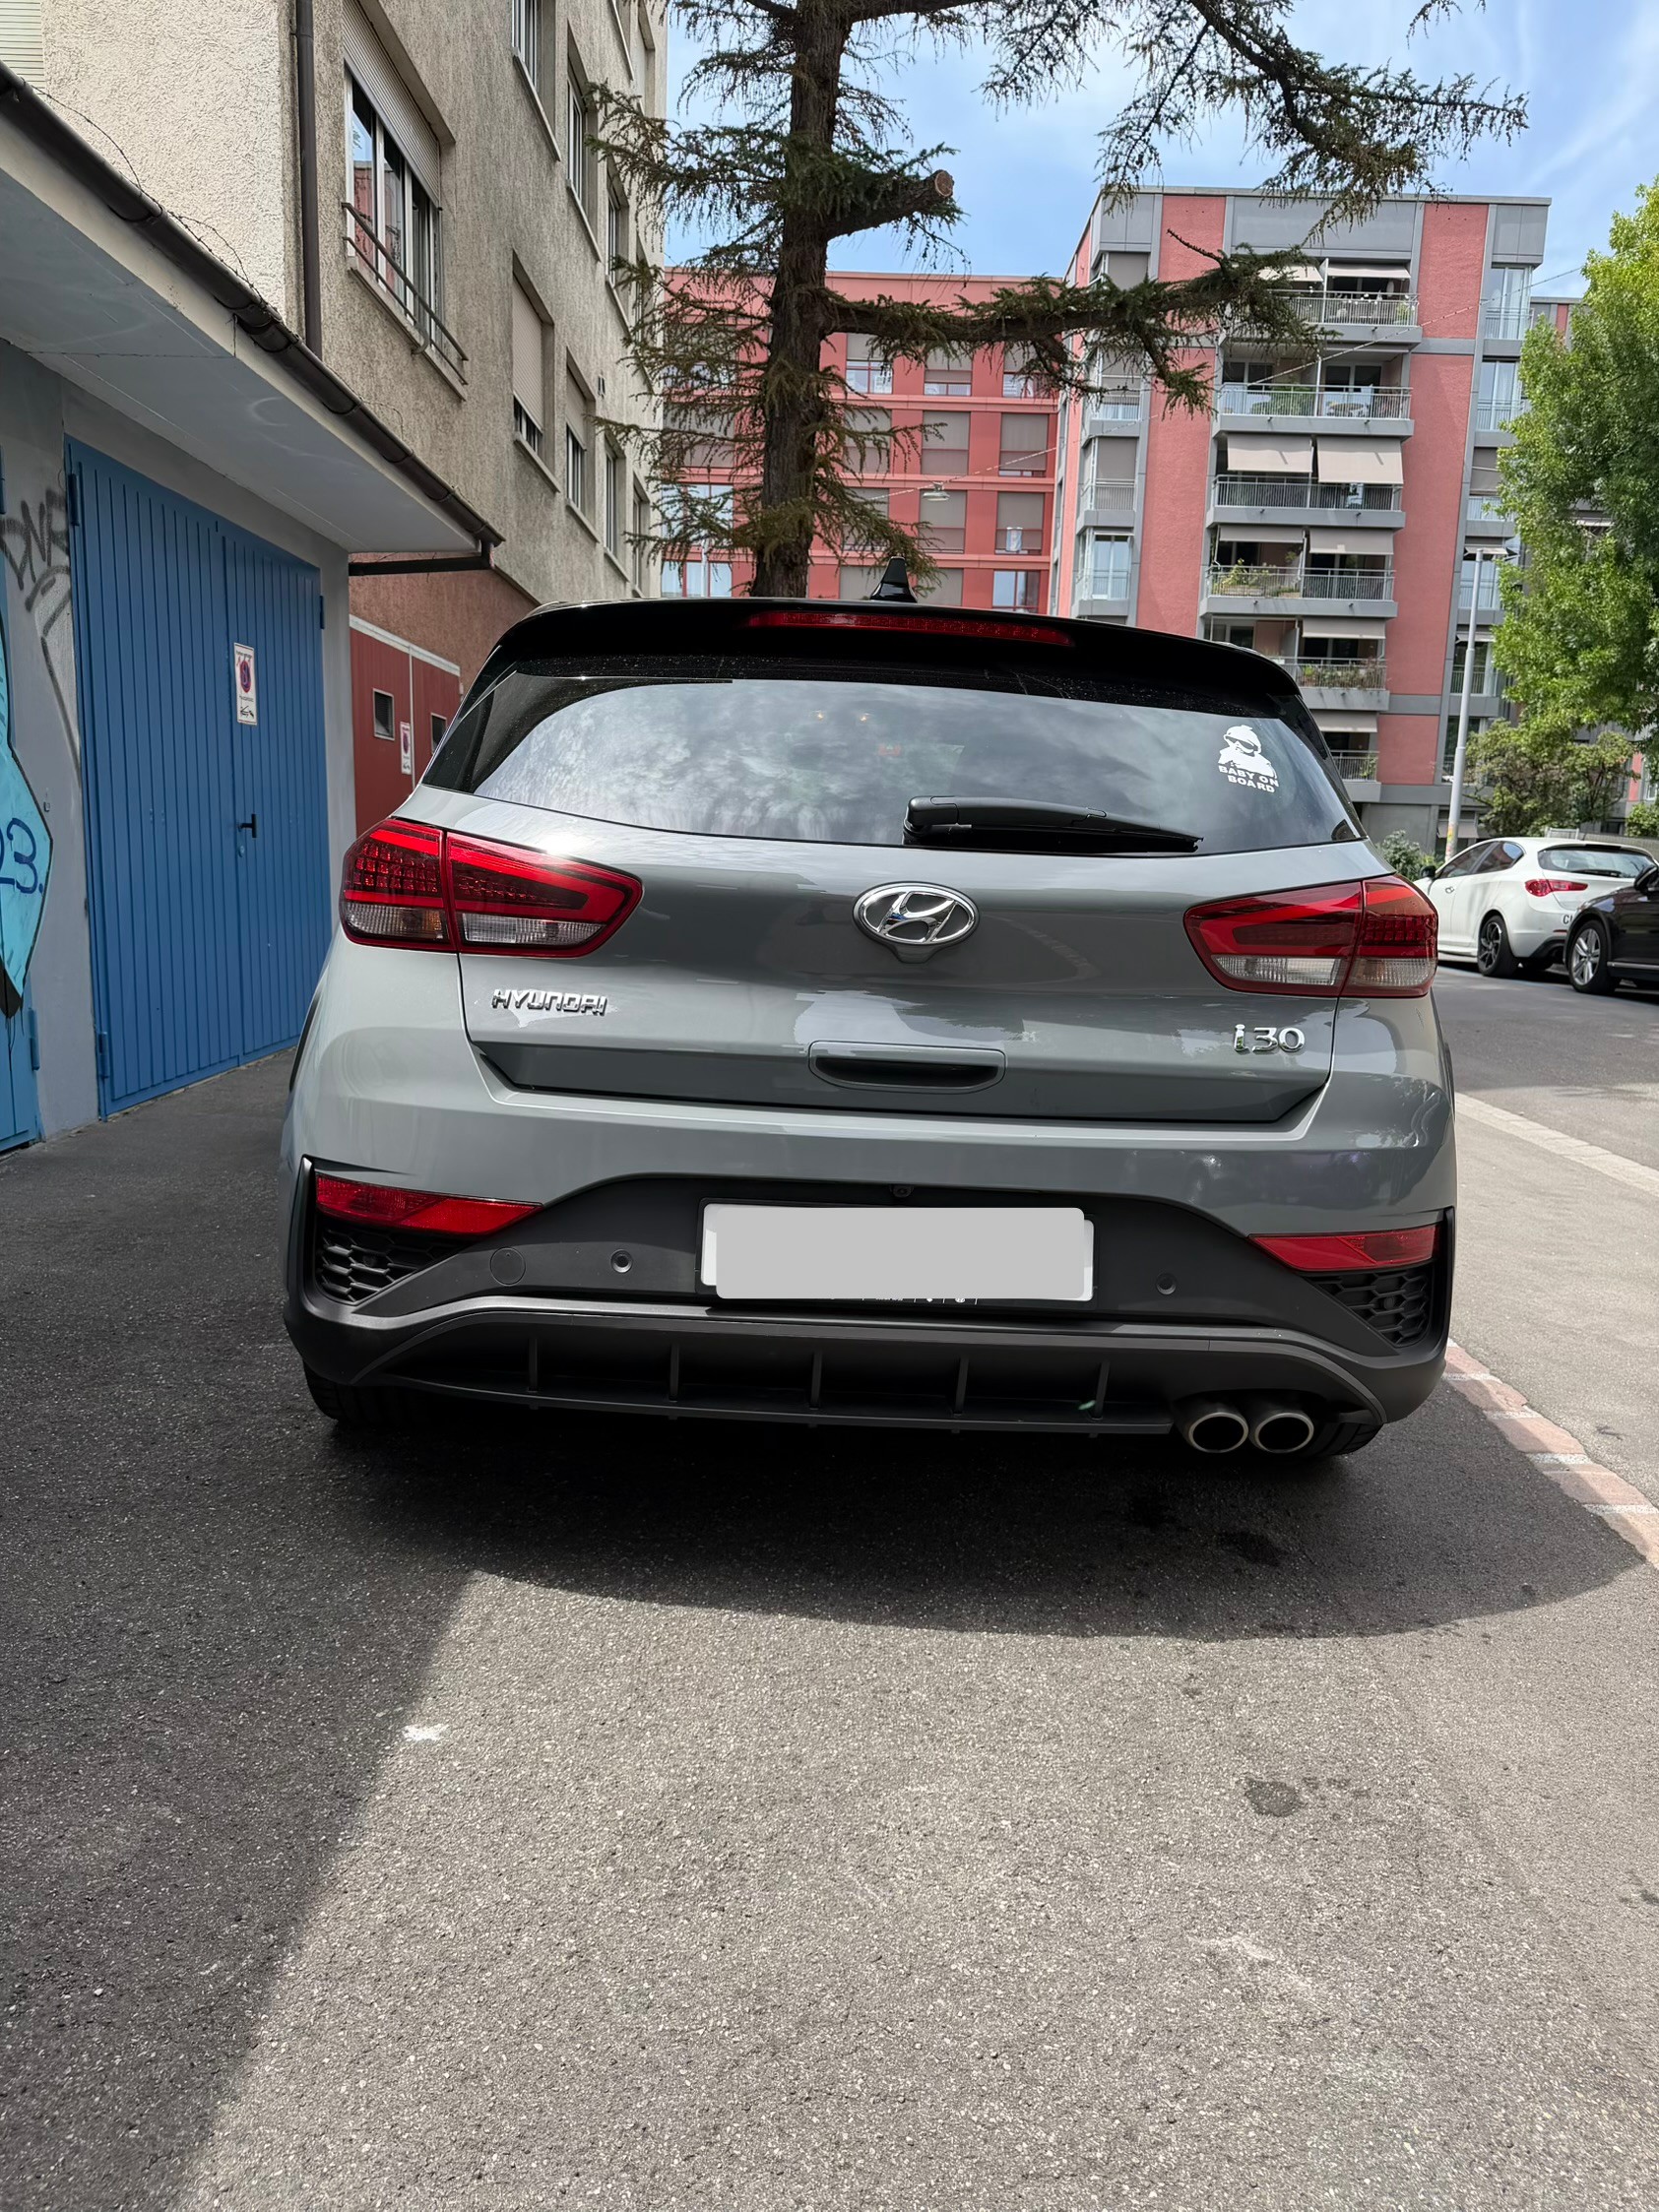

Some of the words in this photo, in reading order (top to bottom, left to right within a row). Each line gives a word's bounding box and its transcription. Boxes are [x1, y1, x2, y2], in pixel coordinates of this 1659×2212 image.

[1218, 765, 1255, 780] BABY
[1258, 775, 1280, 788] ON
[1227, 774, 1275, 793] BOARD
[491, 988, 608, 1016] HYUNDAI
[1234, 1024, 1306, 1053] i30
